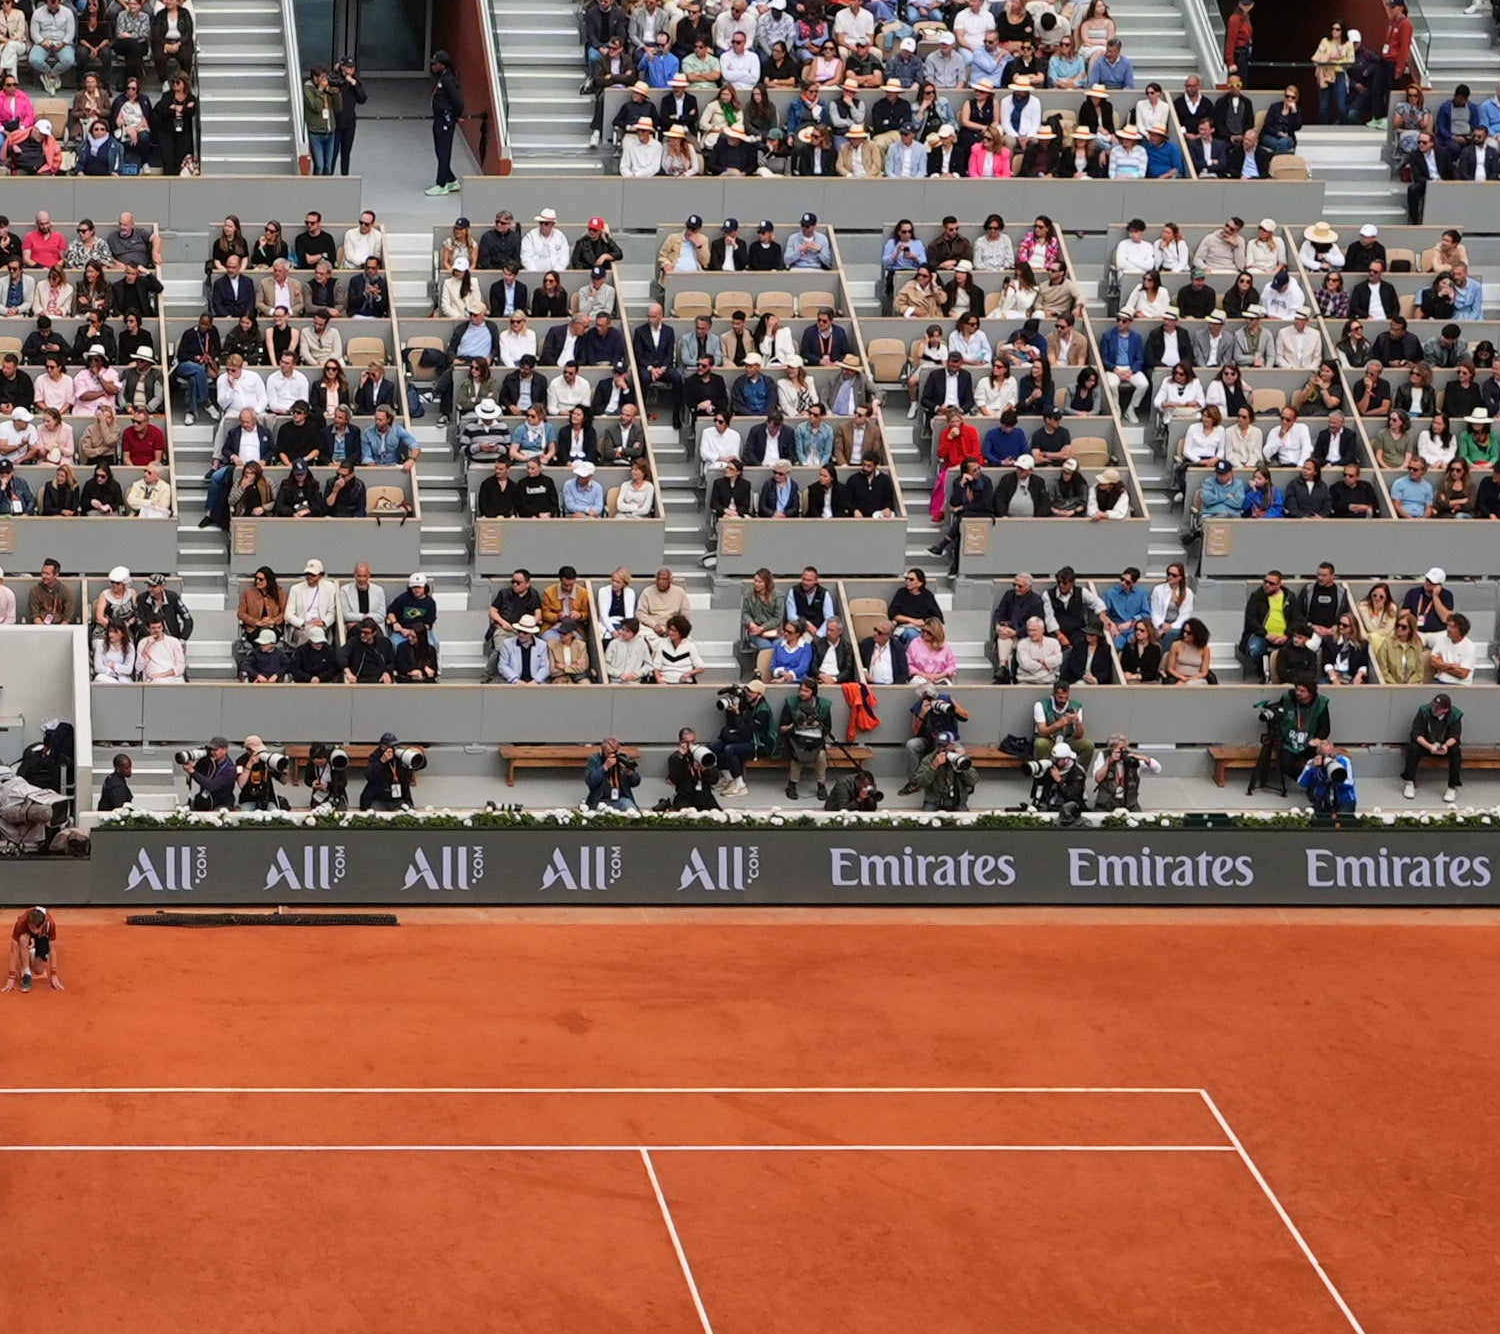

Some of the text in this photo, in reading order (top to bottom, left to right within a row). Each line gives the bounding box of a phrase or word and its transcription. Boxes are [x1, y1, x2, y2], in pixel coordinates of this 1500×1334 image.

[830, 847, 1015, 888] Emirates
[1069, 847, 1254, 888] Emirates
[1307, 847, 1492, 888] Emirates
